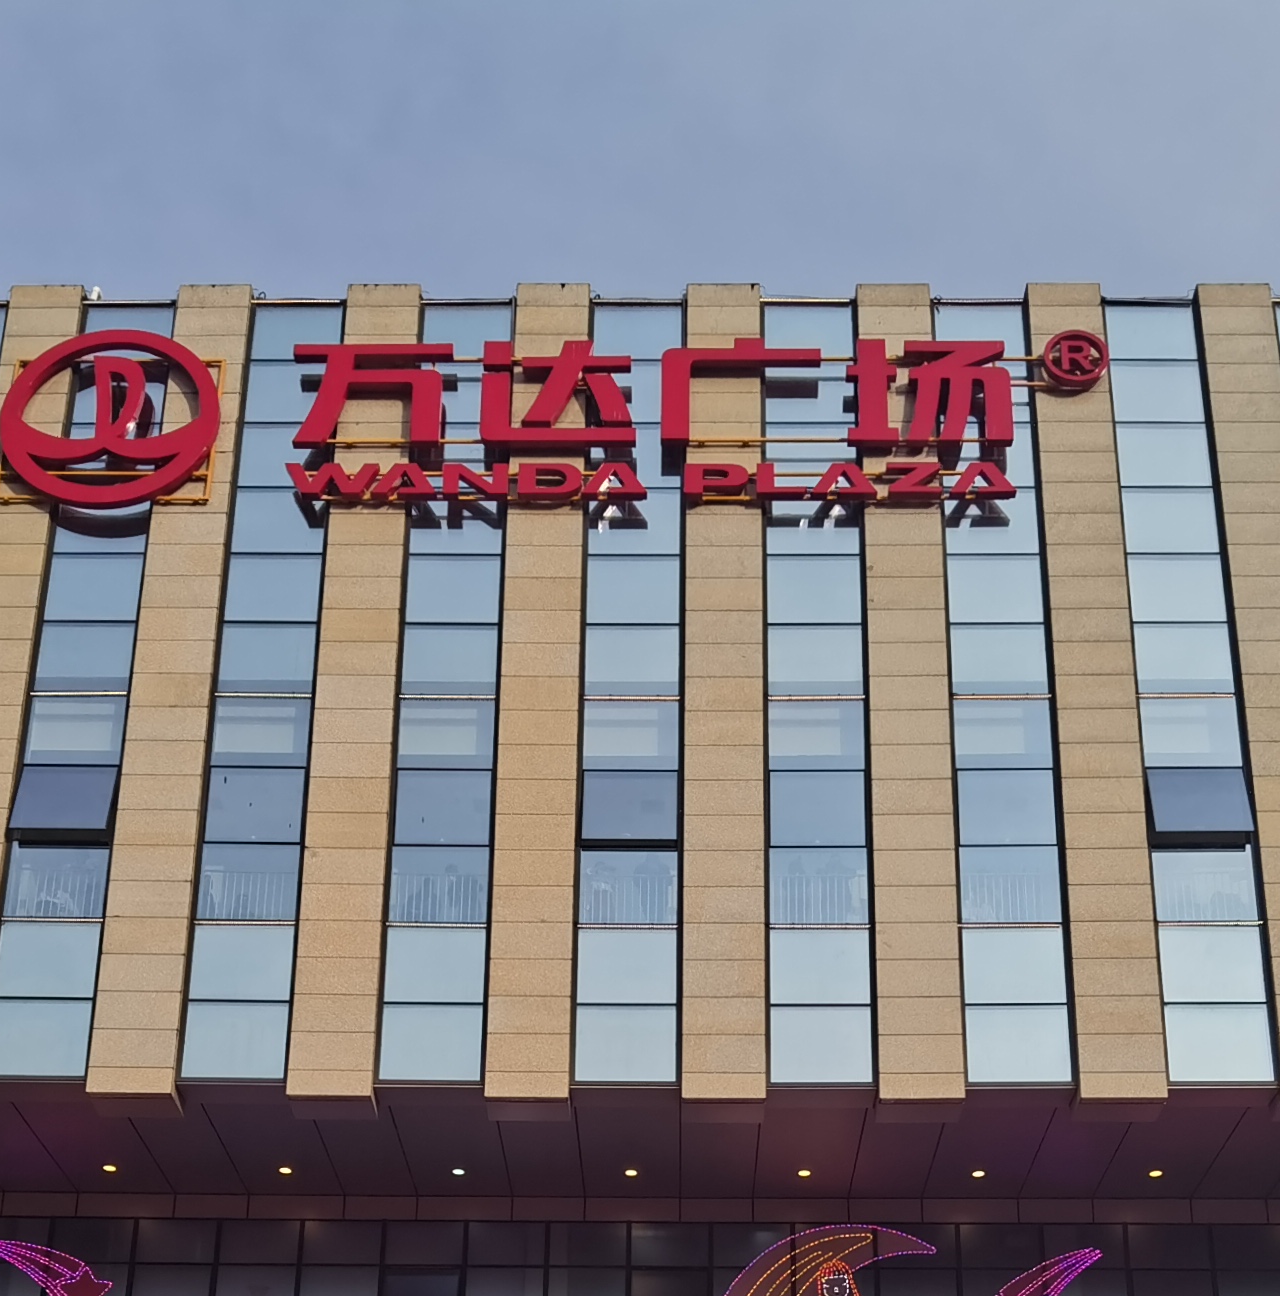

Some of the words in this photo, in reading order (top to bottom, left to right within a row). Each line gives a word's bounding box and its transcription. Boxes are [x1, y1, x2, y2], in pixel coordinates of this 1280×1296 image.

[291, 336, 1012, 447] 万达广场
[286, 461, 647, 501] WANDA
[684, 461, 1017, 501] PLAZA
